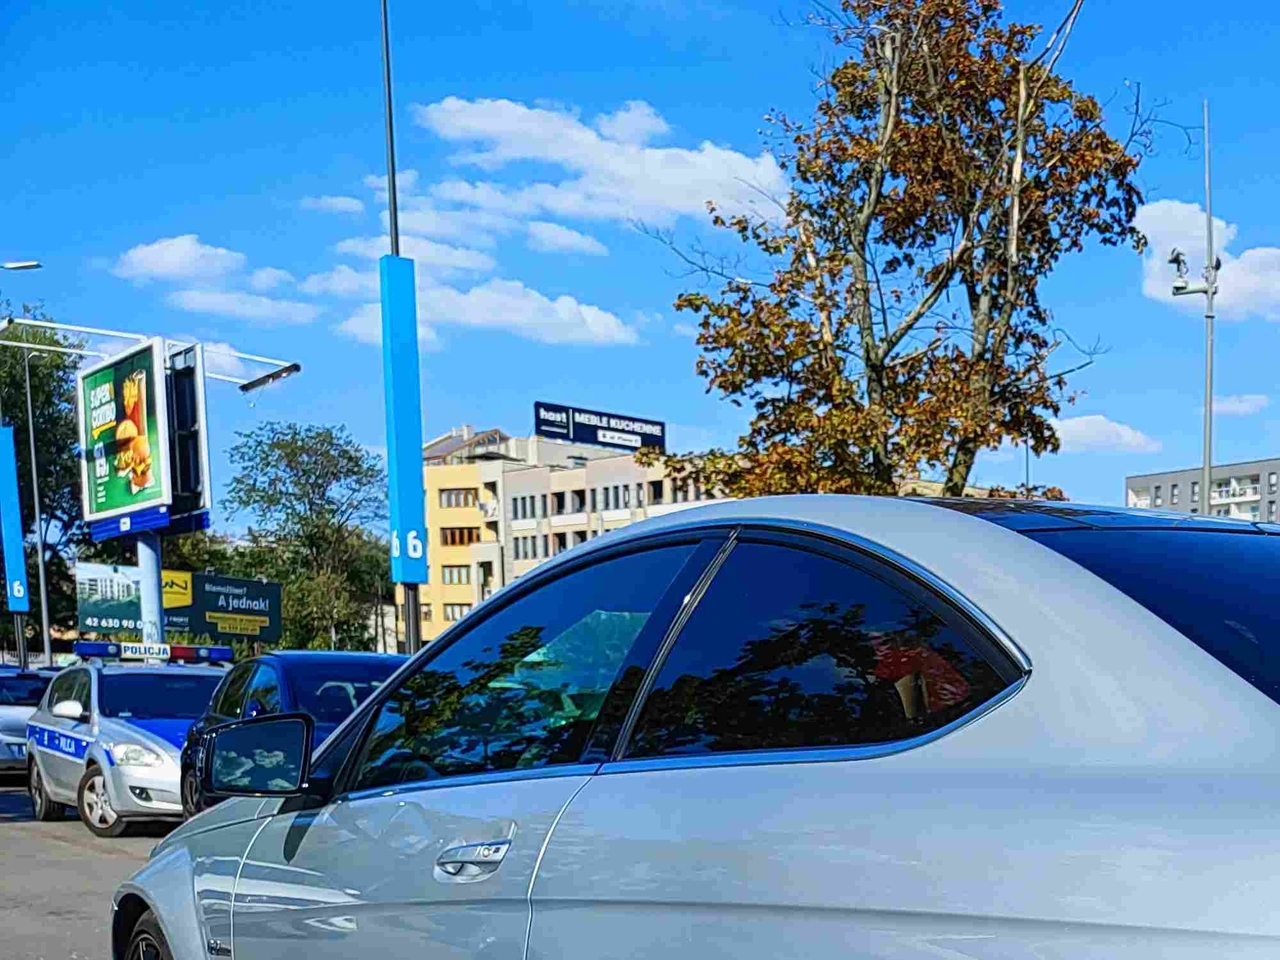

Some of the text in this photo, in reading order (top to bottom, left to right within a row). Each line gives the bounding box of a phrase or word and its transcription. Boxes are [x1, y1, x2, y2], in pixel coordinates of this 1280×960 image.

[574, 411, 608, 428] MEBLE
[407, 529, 423, 559] 6
[13, 580, 25, 598] 6
[218, 594, 227, 607] A
[85, 617, 99, 627] 42
[100, 618, 120, 629] 630
[123, 645, 169, 656] POLICJA
